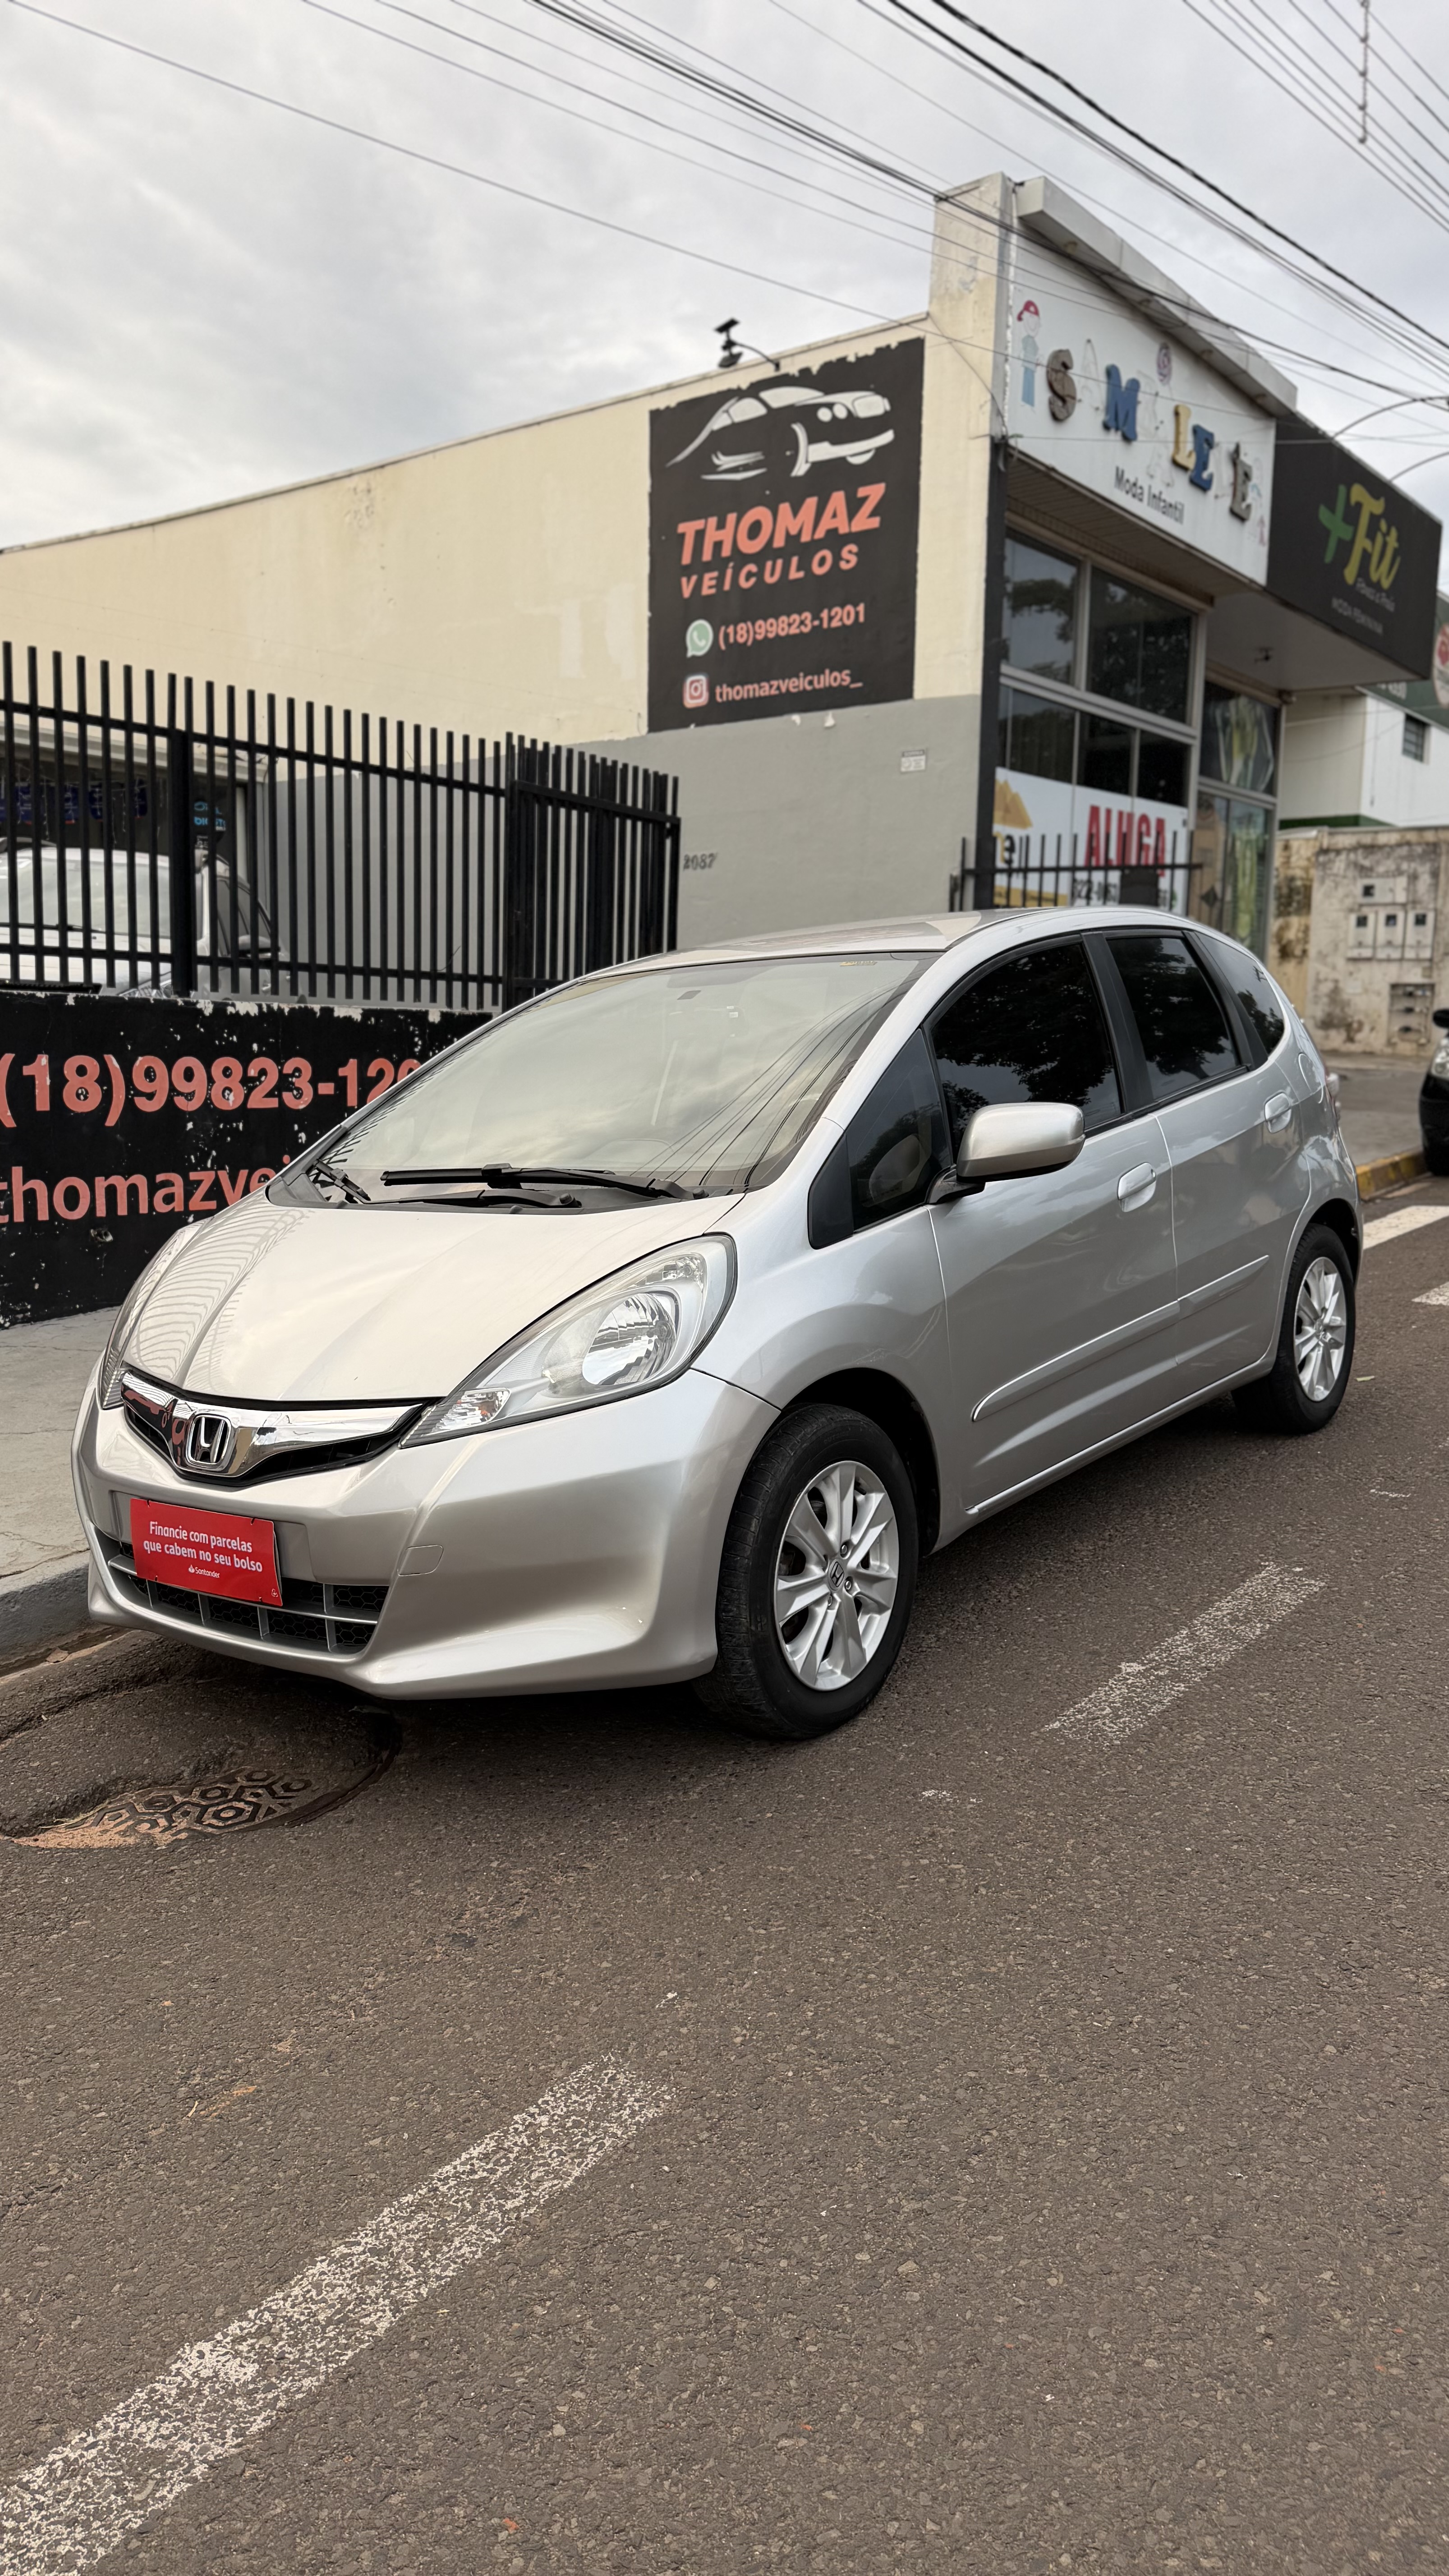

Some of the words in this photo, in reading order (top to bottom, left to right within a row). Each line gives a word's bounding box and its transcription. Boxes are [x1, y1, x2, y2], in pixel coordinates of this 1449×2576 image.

[1114, 465, 1144, 503] Moda
[1147, 484, 1185, 525] Infantil
[676, 482, 886, 566] THOMAZ
[681, 543, 859, 599] VEÍCULOS
[718, 602, 865, 650] (18)99823-1201
[715, 668, 863, 703] thomazveiculos_
[1084, 805, 1165, 877] ALUGA
[143, 1540, 162, 1554] que
[164, 1542, 197, 1559] cabem
[199, 1550, 212, 1562] no
[214, 1553, 231, 1566] seu
[234, 1554, 263, 1573] bolso
[150, 1521, 188, 1540] Financie
[189, 1531, 208, 1544] com
[210, 1537, 253, 1553] parcelas
[195, 1567, 220, 1578] Santander
